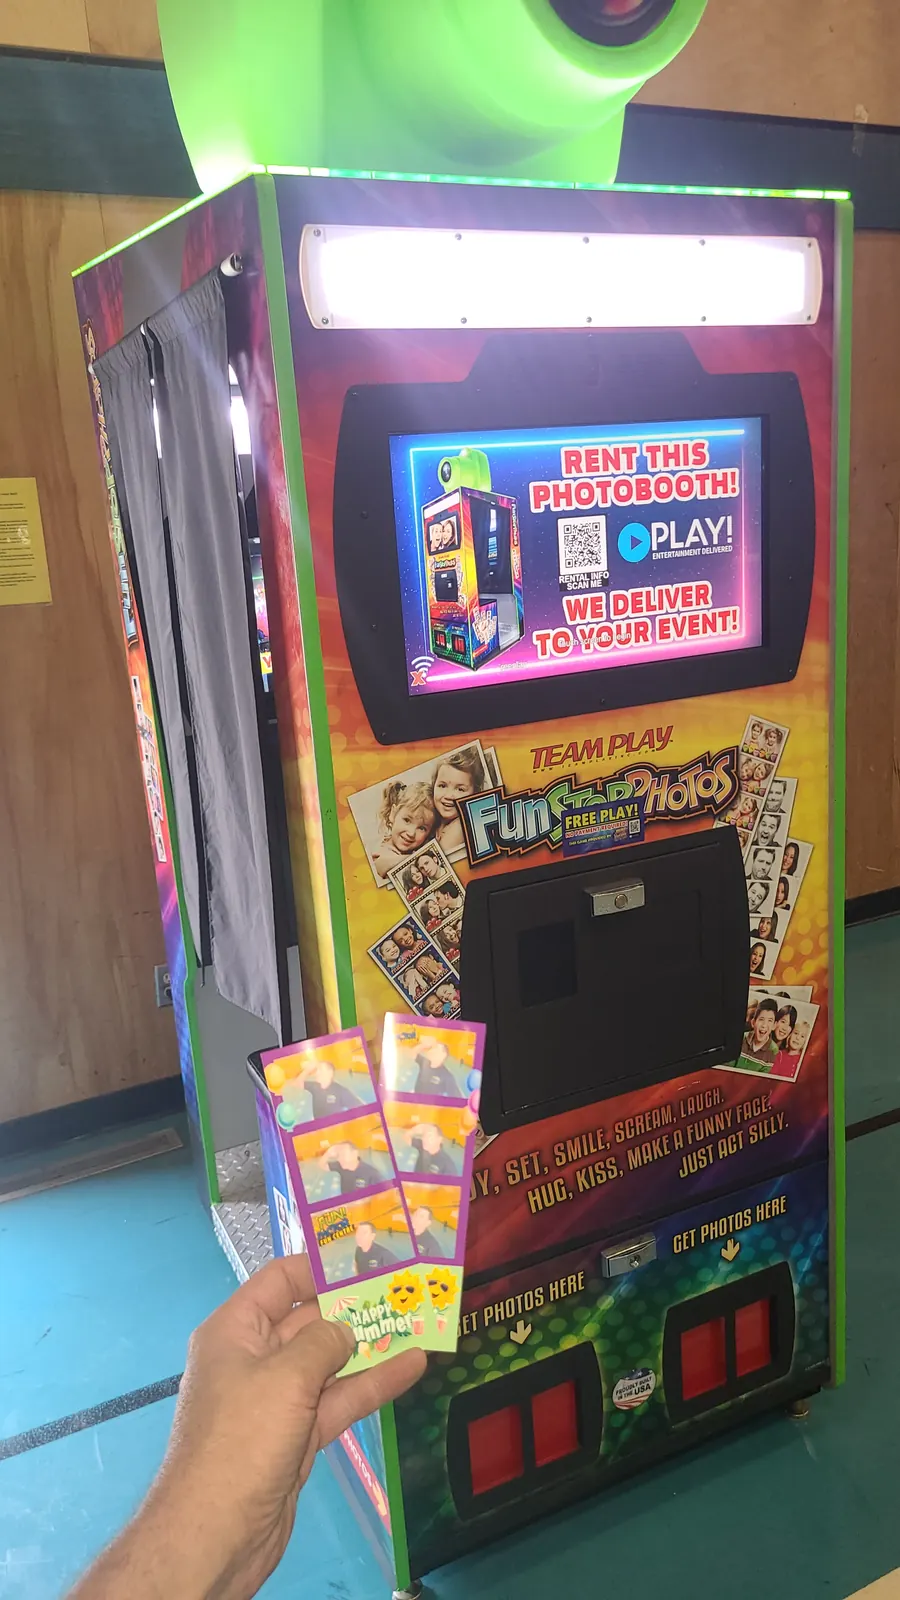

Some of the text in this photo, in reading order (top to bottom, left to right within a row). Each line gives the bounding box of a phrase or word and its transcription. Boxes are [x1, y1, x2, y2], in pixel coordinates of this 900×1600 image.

[563, 442, 708, 475] RENT THIS
[532, 471, 737, 510] PHOTOBOOTH!
[650, 515, 733, 551] PLAY!
[652, 545, 733, 560] ENTERTAINMENT DELIVERED
[558, 571, 610, 584] RENTAL INFO
[566, 579, 603, 591] SCAN ME
[565, 584, 710, 622] WE DELIVER
[535, 609, 738, 656] TO YOUR EVENT!
[530, 725, 674, 770] TEAM PLAY
[565, 803, 639, 830] FREE PLAY!
[505, 1151, 549, 1186] SET,
[553, 1127, 612, 1168] SMILE,
[614, 1107, 678, 1144] SCREAM,
[680, 1087, 725, 1119] LAUGH.
[678, 1111, 789, 1180] JUST ACT SILLY.
[527, 1177, 574, 1214] HUG,
[575, 1157, 625, 1194] KISS,
[627, 1135, 671, 1171] MAKE
[673, 1129, 684, 1151] A
[686, 1107, 734, 1146] FUNNY
[673, 1195, 788, 1255] GET PHOTOS HERE
[351, 1302, 393, 1327] HAPPY
[483, 1286, 545, 1327] PHOTOS
[549, 1271, 585, 1302] HERE
[353, 1311, 413, 1343] ummer
[616, 1382, 638, 1395] PROUDLY
[634, 1383, 651, 1395] USA
